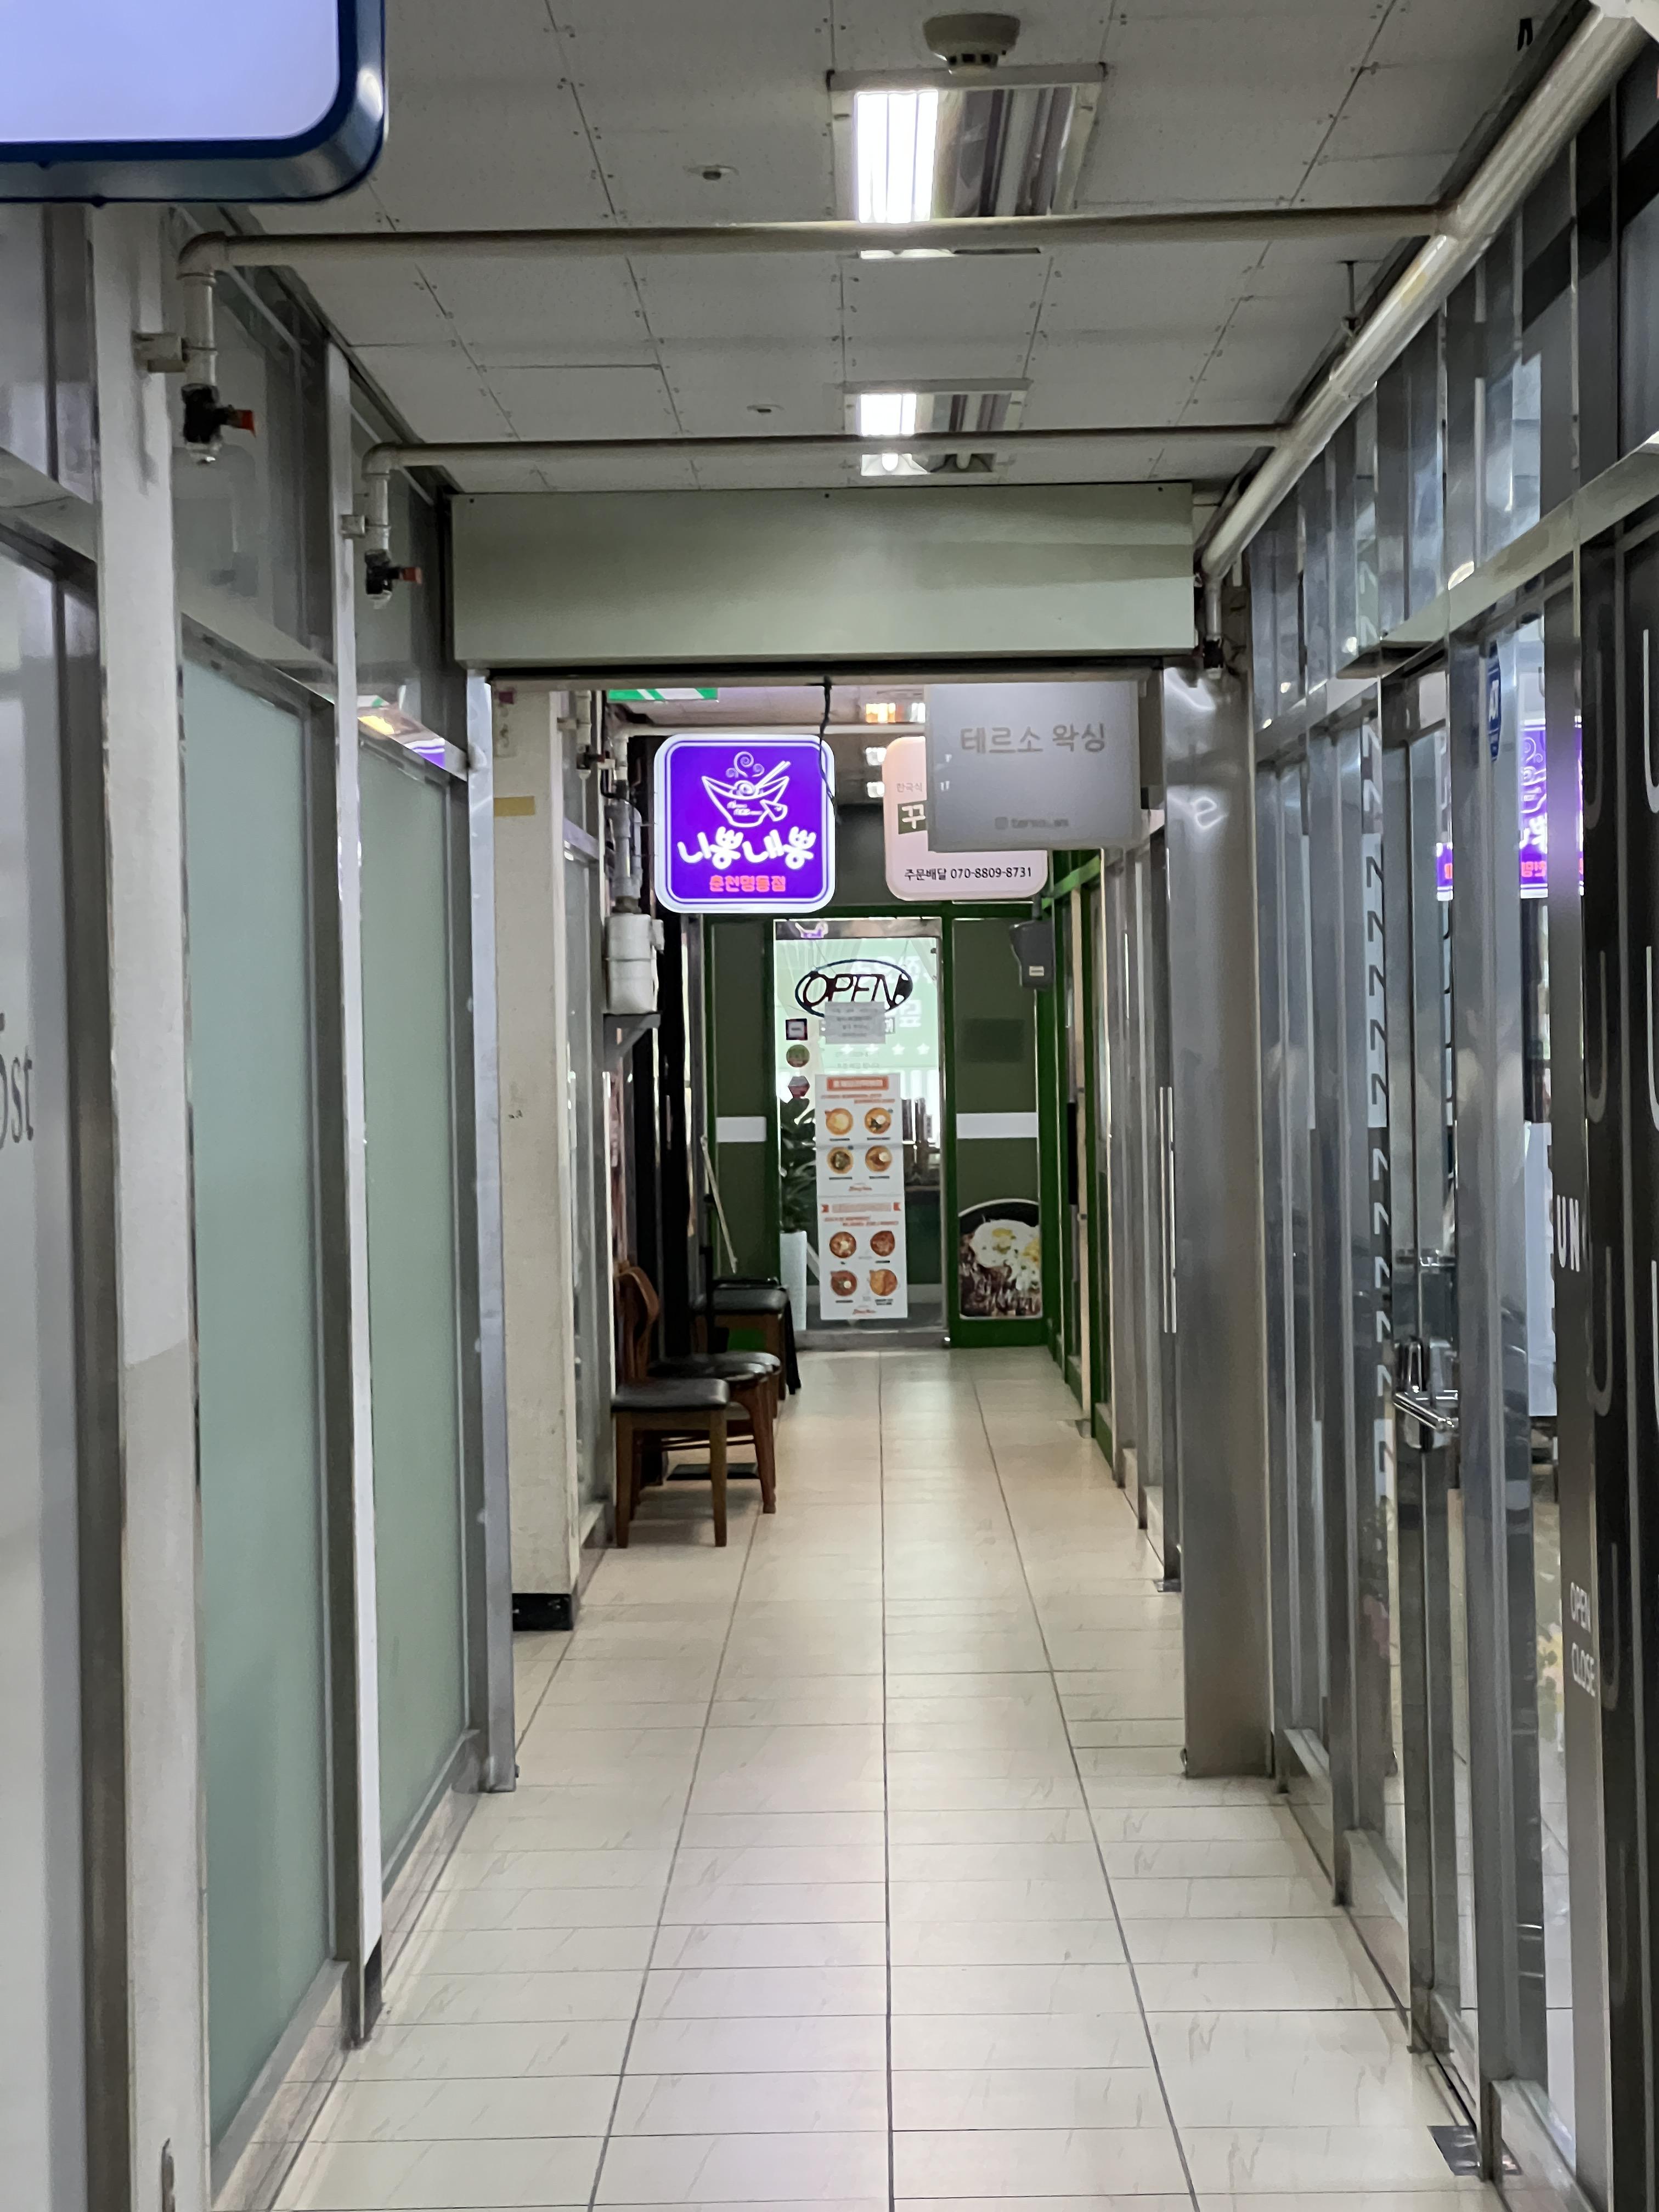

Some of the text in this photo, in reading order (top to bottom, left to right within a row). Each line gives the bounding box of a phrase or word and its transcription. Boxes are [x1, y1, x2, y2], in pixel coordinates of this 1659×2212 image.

[960, 722, 1106, 754] 테르소 왁싱
[676, 826, 817, 870] 니뽕내뽕
[904, 866, 1031, 881] 주문배달 070-8809-8731
[802, 973, 906, 1009] OPEN
[1570, 1582, 1591, 1633] OPEN
[1572, 1642, 1596, 1698] CLOSE
